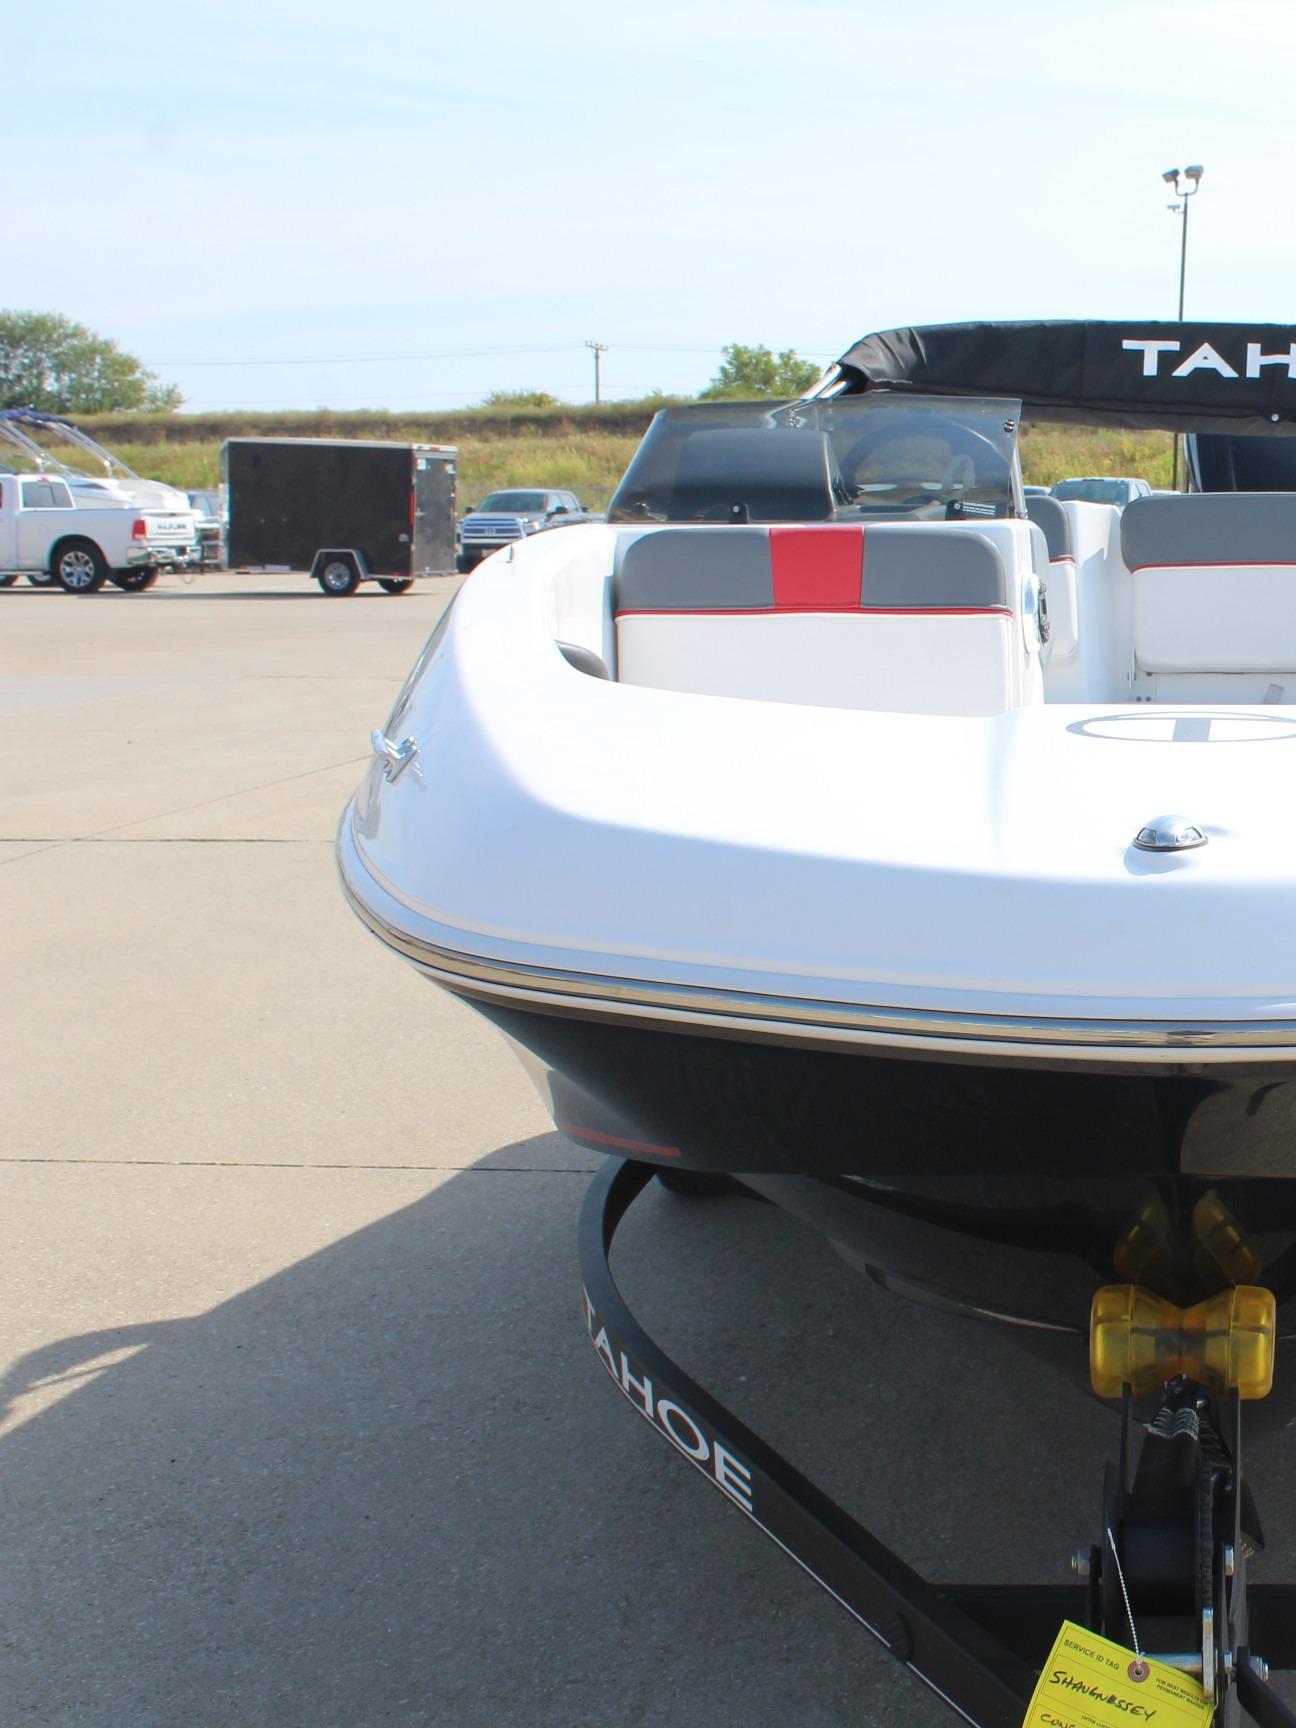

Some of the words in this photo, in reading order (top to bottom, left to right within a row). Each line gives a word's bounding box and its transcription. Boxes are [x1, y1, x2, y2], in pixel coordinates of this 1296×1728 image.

[582, 1283, 753, 1513] TAHOE
[1063, 1639, 1095, 1658] SERVICE
[1096, 1654, 1104, 1662] ID
[1104, 1658, 1120, 1670] TAG
[1156, 1684, 1186, 1701] PERMANENT
